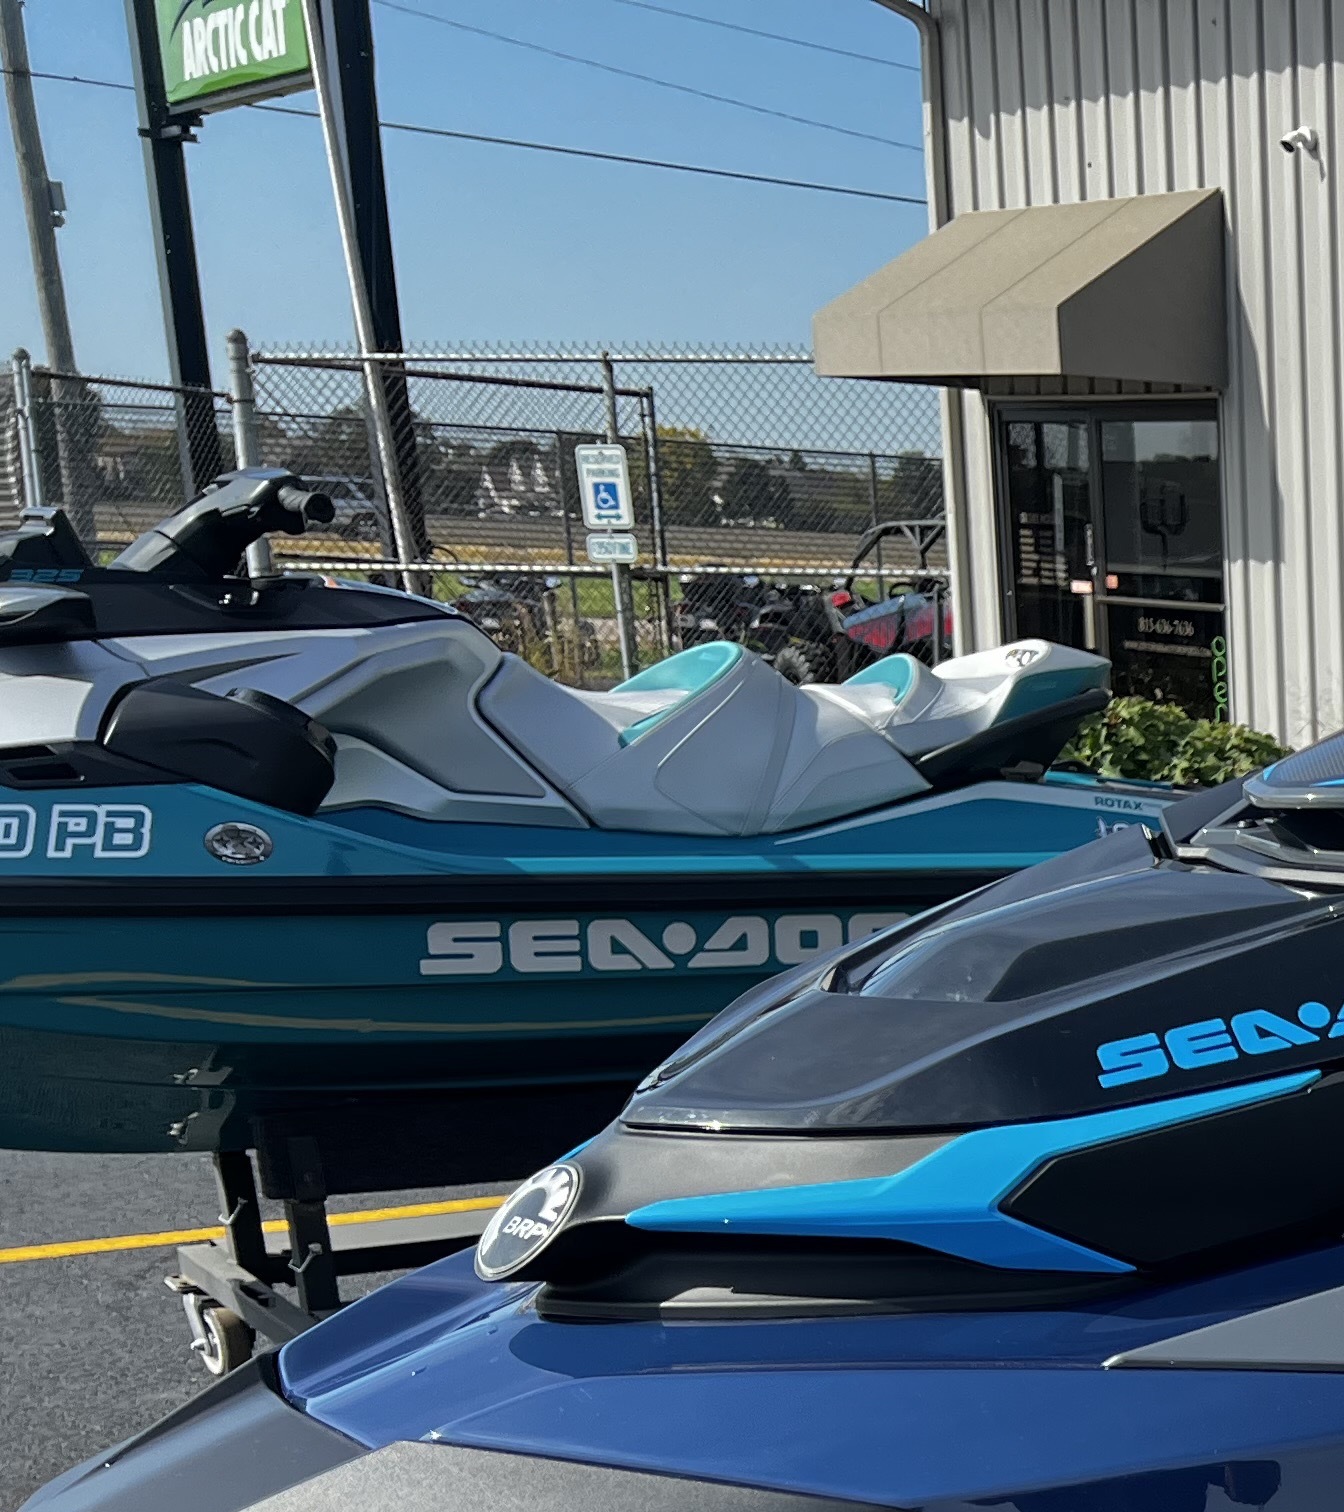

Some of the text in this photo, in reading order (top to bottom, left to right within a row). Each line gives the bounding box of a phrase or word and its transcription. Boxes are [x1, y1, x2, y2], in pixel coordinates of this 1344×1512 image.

[182, 0, 287, 81] ARCTIC CAT
[8, 568, 85, 583] 325
[1094, 796, 1143, 811] ROTAX
[47, 803, 152, 859] PB
[502, 1216, 550, 1240] BRP
